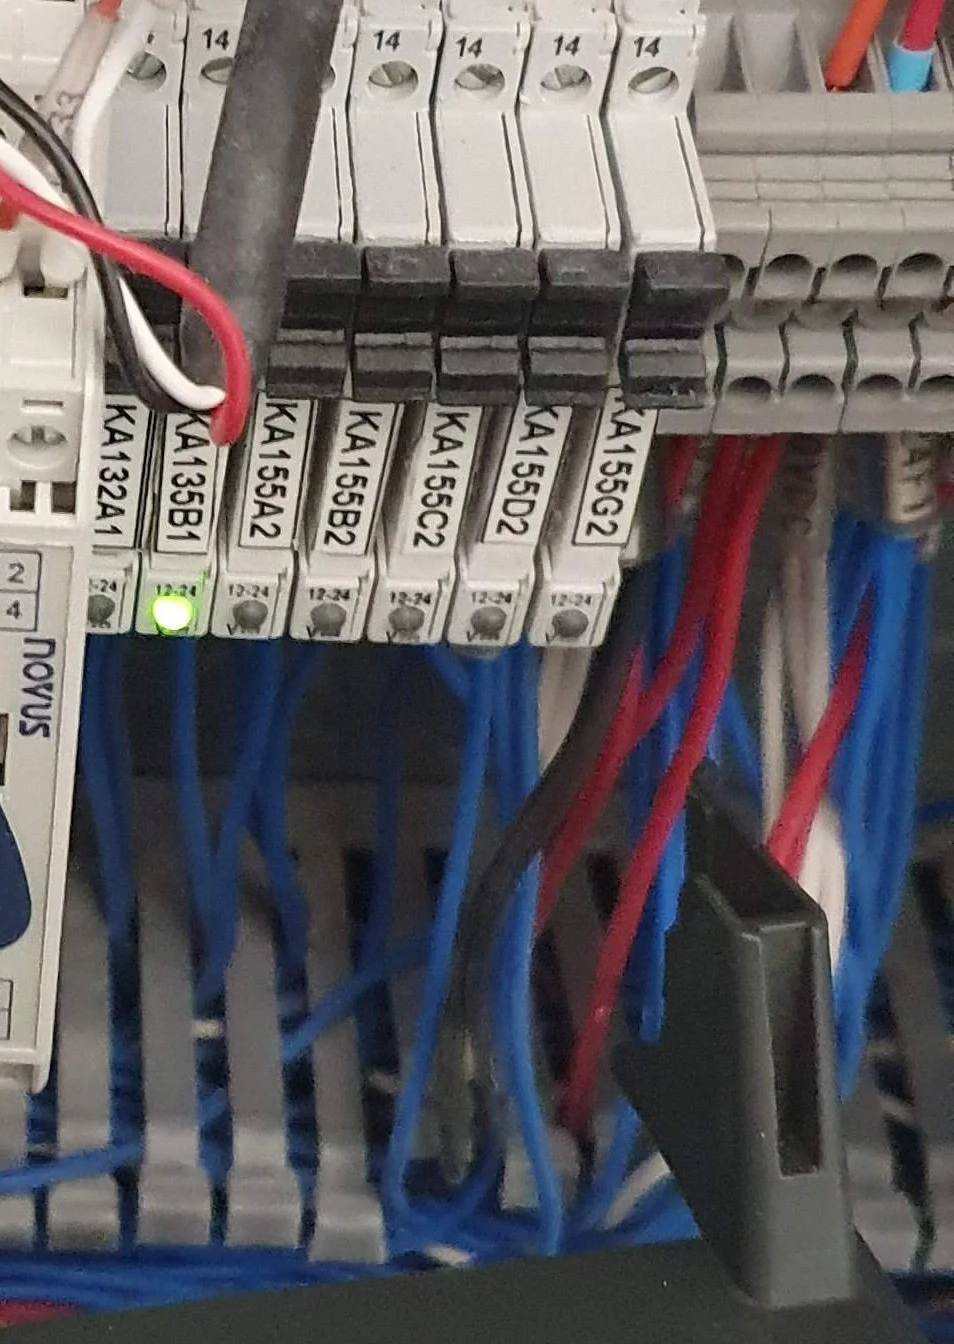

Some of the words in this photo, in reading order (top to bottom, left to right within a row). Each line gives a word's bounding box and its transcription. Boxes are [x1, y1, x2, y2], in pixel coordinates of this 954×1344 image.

[201, 28, 229, 50] 14
[373, 30, 401, 51] 14
[455, 36, 483, 58] 14
[554, 34, 580, 56] 14
[633, 36, 661, 58] 14
[93, 404, 138, 536] KA132A1
[165, 413, 212, 542] KA135B1
[249, 402, 299, 539] KA155A2
[324, 410, 383, 547] KA155B2
[413, 411, 470, 549] KA155C2
[496, 405, 559, 536] KA155D2
[585, 406, 645, 536] KA155G2
[5, 600, 21, 620] 4
[7, 562, 26, 584] 2
